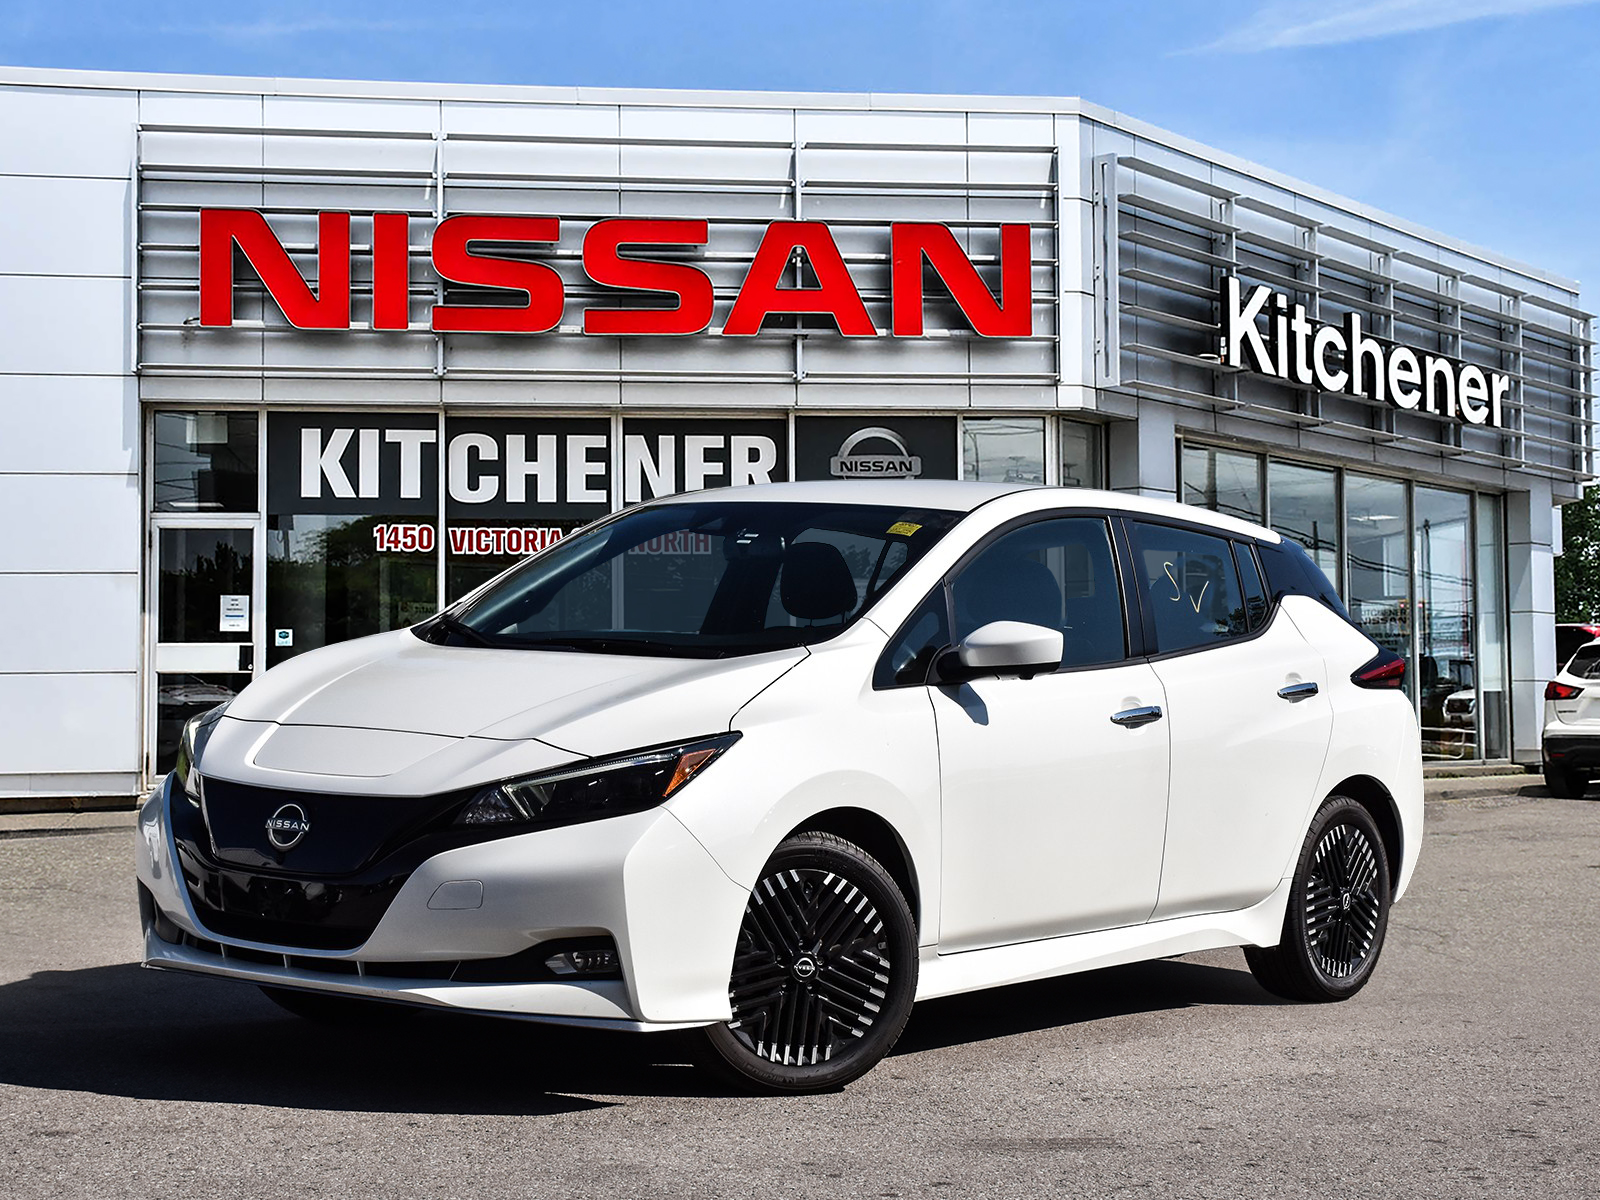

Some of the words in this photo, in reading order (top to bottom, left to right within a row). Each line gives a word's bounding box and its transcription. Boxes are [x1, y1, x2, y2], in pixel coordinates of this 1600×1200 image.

[199, 208, 1033, 338] NISSAN
[1227, 276, 1510, 428] Kitchener
[840, 460, 913, 473] NISSAN
[374, 524, 435, 552] 1450
[265, 819, 310, 831] NISSAN
